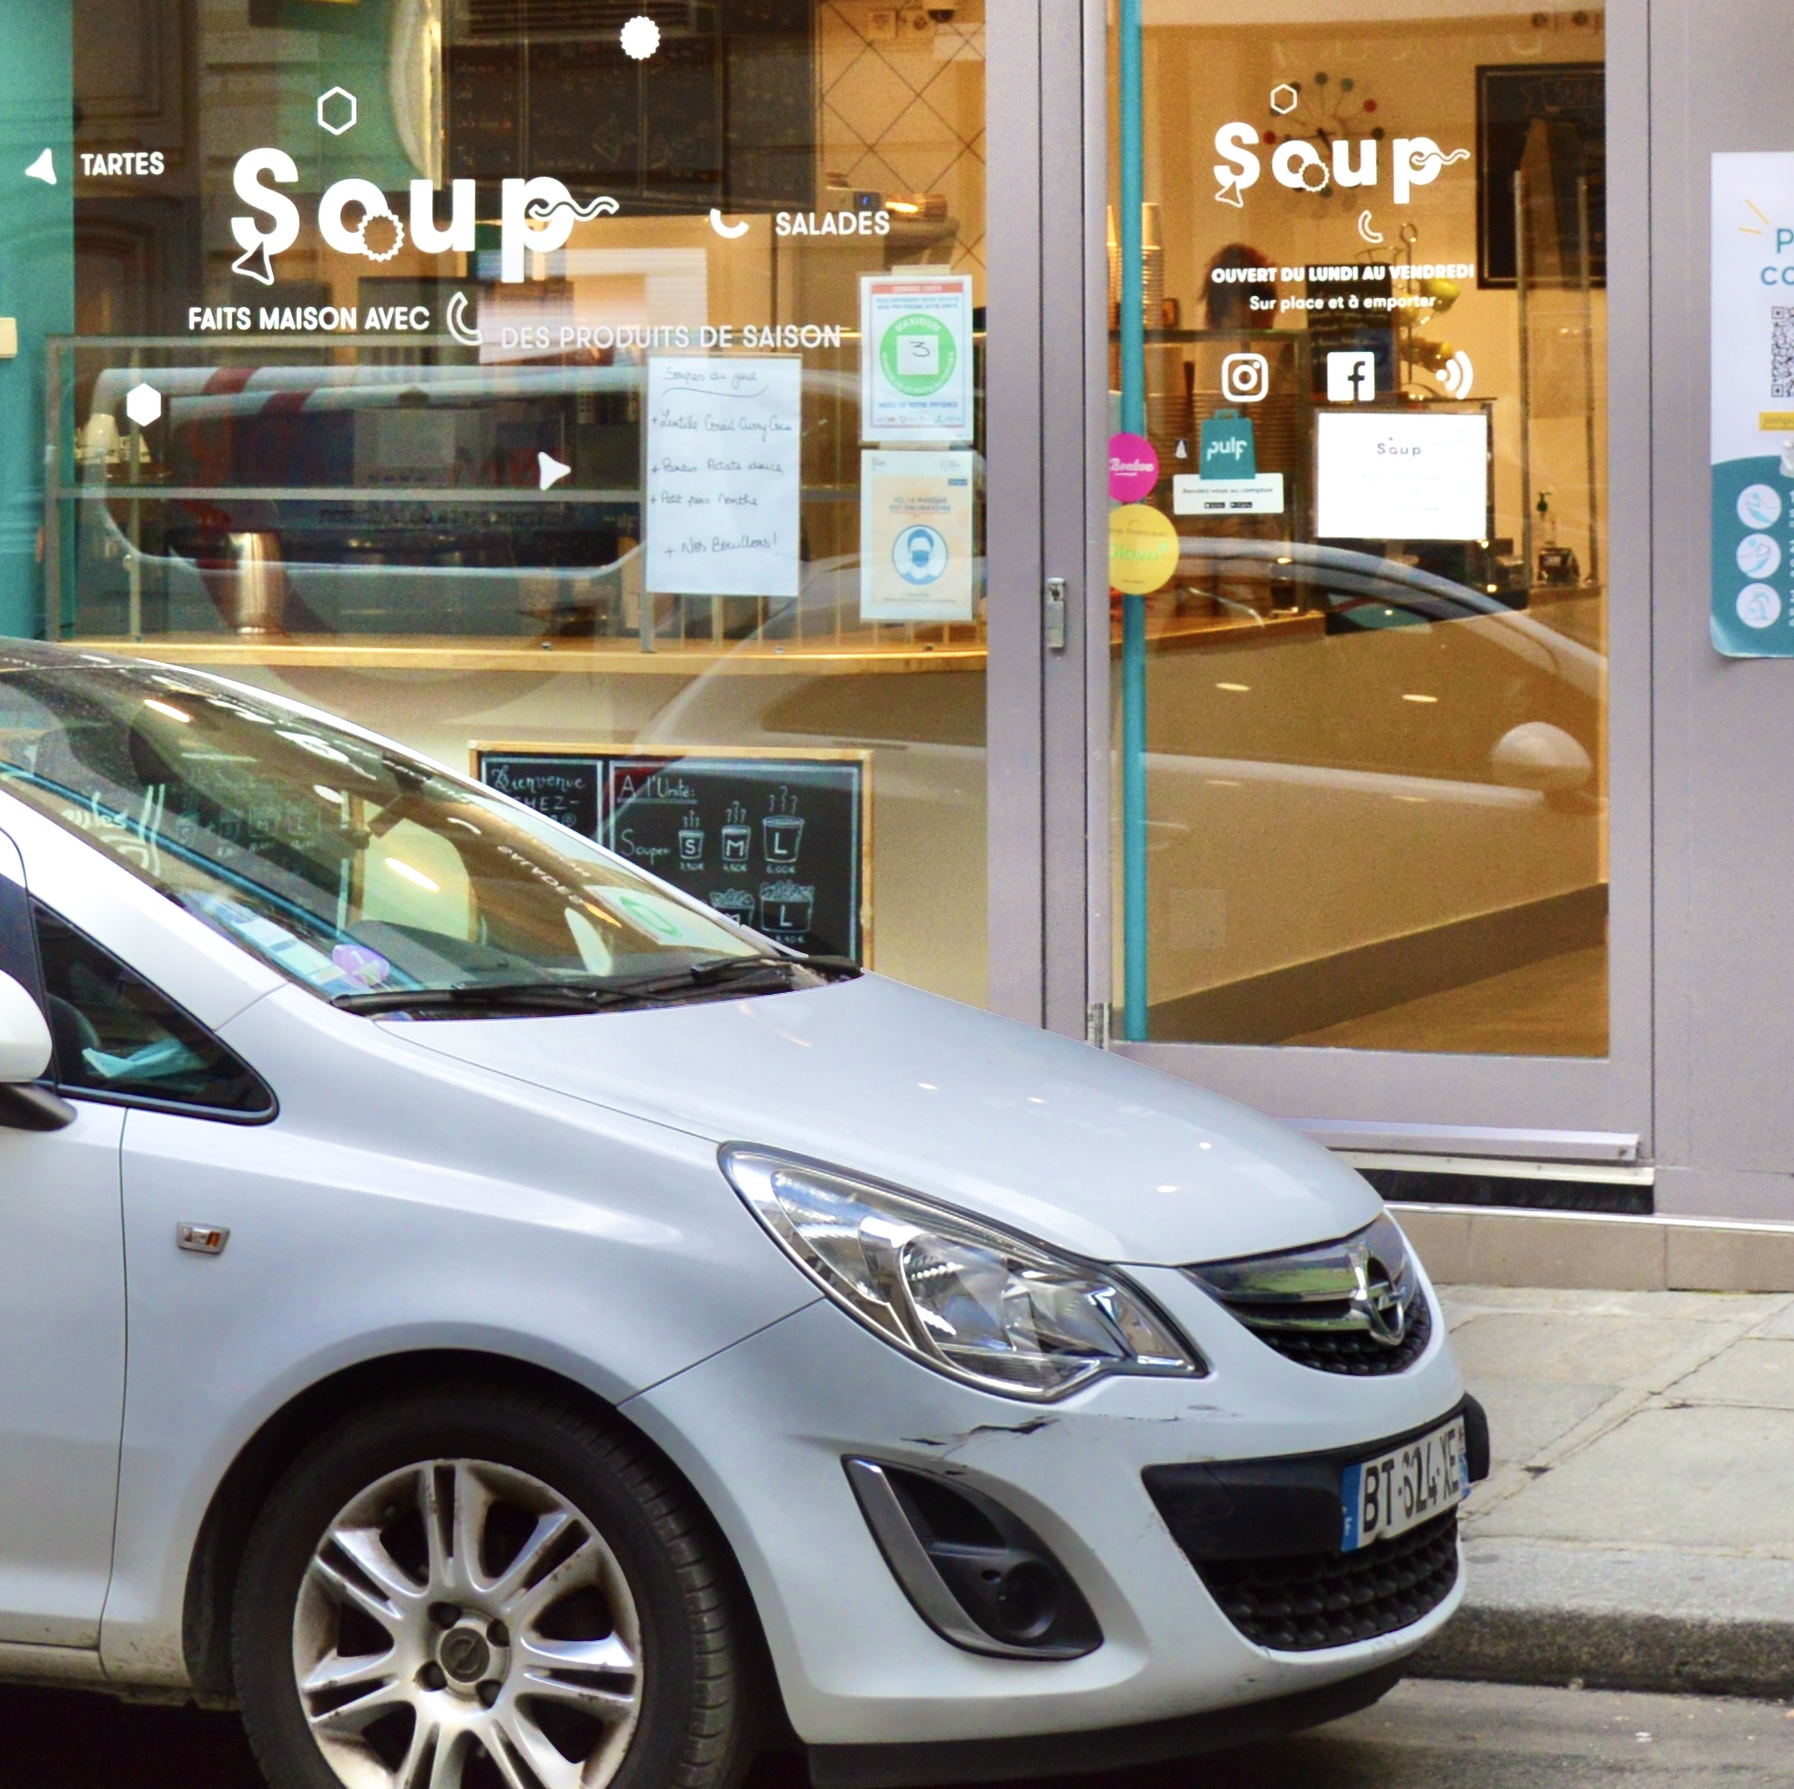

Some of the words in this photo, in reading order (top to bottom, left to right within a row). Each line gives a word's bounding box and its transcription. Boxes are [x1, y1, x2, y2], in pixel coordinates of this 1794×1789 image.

[80, 151, 166, 177] TARTES
[1213, 122, 1443, 204] Soup
[231, 147, 576, 283] Soup
[774, 210, 891, 237] SALADES
[1211, 267, 1278, 283] OUVERT
[1281, 267, 1305, 282] DU
[1309, 266, 1359, 282] LUNDI
[1362, 266, 1386, 280] AU
[1389, 264, 1475, 280] VENDREDI
[1249, 295, 1277, 311] Sur
[1280, 295, 1324, 314] place
[1328, 295, 1344, 309] et
[1348, 294, 1359, 309] à
[1363, 293, 1436, 312] emporter
[188, 306, 253, 331] FAITS
[259, 306, 357, 331] MAISON
[364, 306, 430, 331] AVEC
[502, 327, 551, 350] DES
[559, 325, 690, 349] PRODUITS
[700, 325, 733, 348] DE
[742, 324, 842, 349] SAISON
[909, 340, 932, 358] 3
[1207, 436, 1248, 462] pulp
[1376, 442, 1423, 458] Soup
[491, 764, 587, 793] Bienvenue
[684, 839, 696, 855] S
[726, 840, 745, 857] M
[774, 832, 788, 855] L
[780, 904, 793, 928] L
